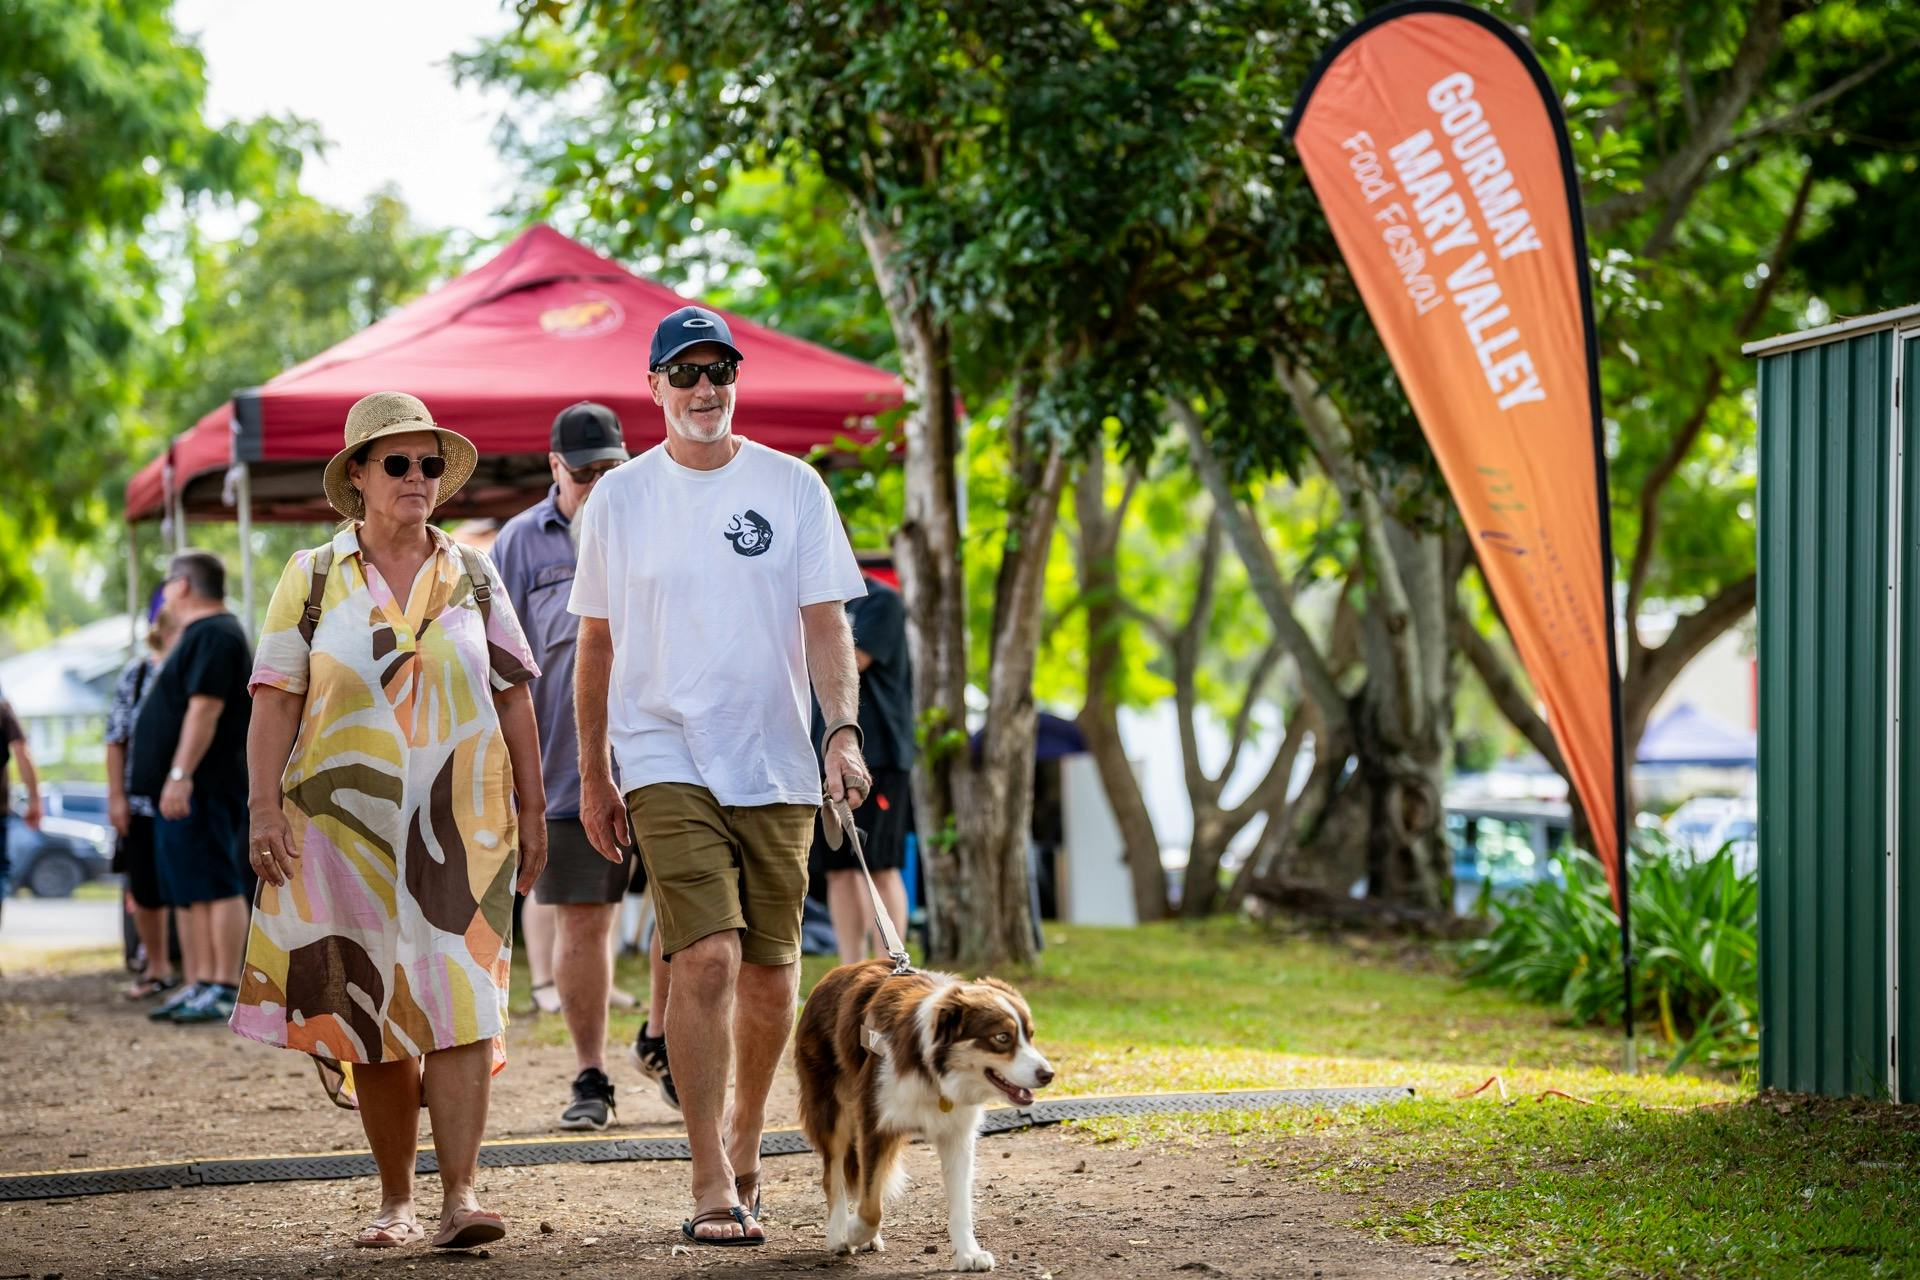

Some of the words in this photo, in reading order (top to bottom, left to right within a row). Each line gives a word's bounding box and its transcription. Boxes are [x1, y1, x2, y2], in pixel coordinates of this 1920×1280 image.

[1341, 131, 1396, 203] Food
[1375, 202, 1445, 316] Festival
[1427, 72, 1543, 260] GOURMAY
[1388, 128, 1479, 256] MARY
[1446, 251, 1547, 411] VALLEY
